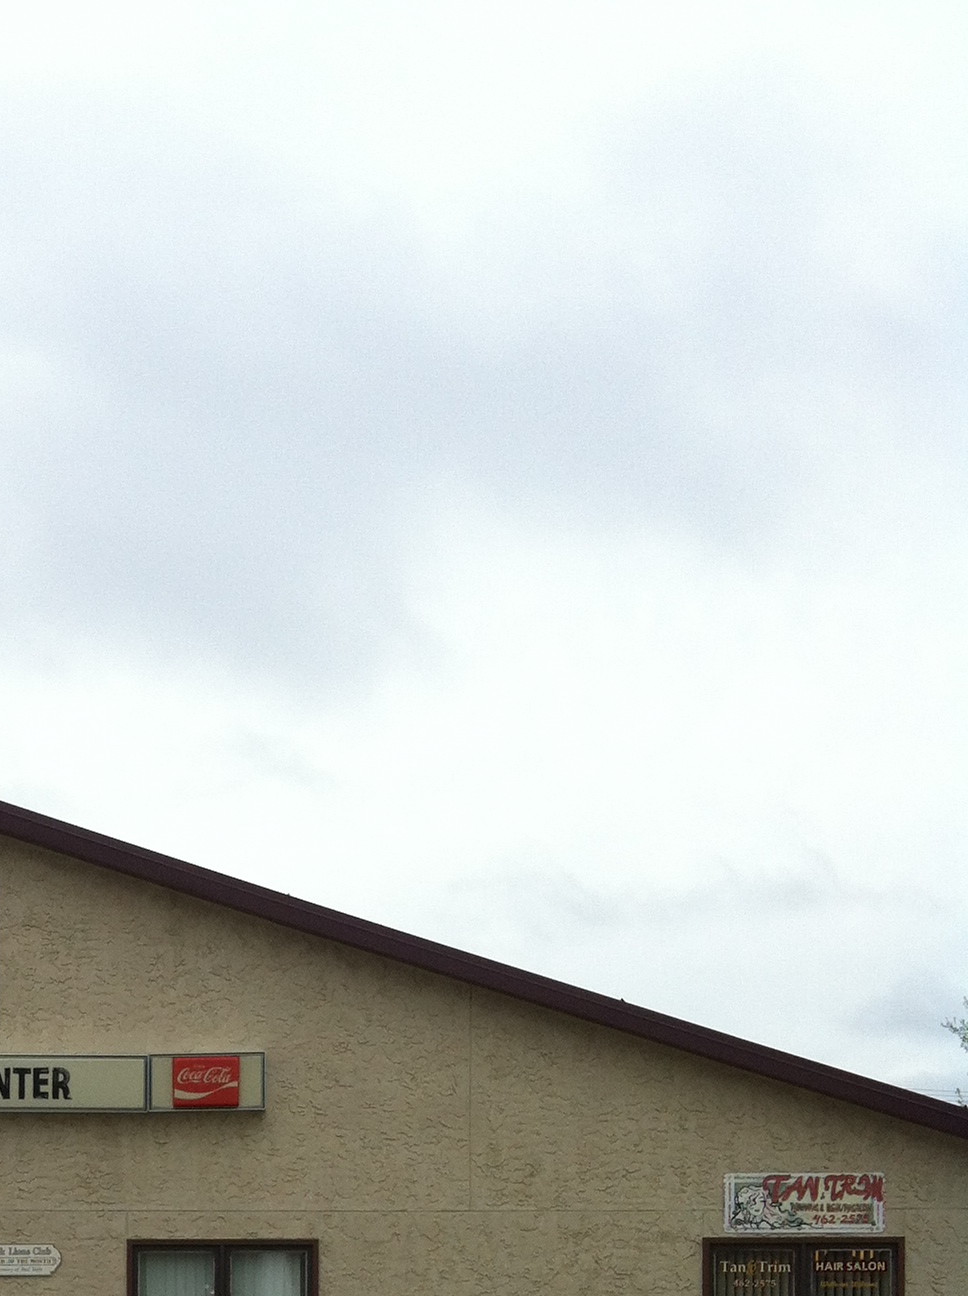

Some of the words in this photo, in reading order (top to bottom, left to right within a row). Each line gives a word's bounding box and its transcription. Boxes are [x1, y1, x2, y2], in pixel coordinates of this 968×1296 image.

[177, 1066, 231, 1084] Coca-Cola
[763, 1174, 820, 1202] TAN
[32, 1247, 52, 1256] Club
[720, 1260, 746, 1273] Tan
[757, 1259, 792, 1273] Trim
[815, 1261, 844, 1271] HAIR
[846, 1261, 886, 1271] SALON
